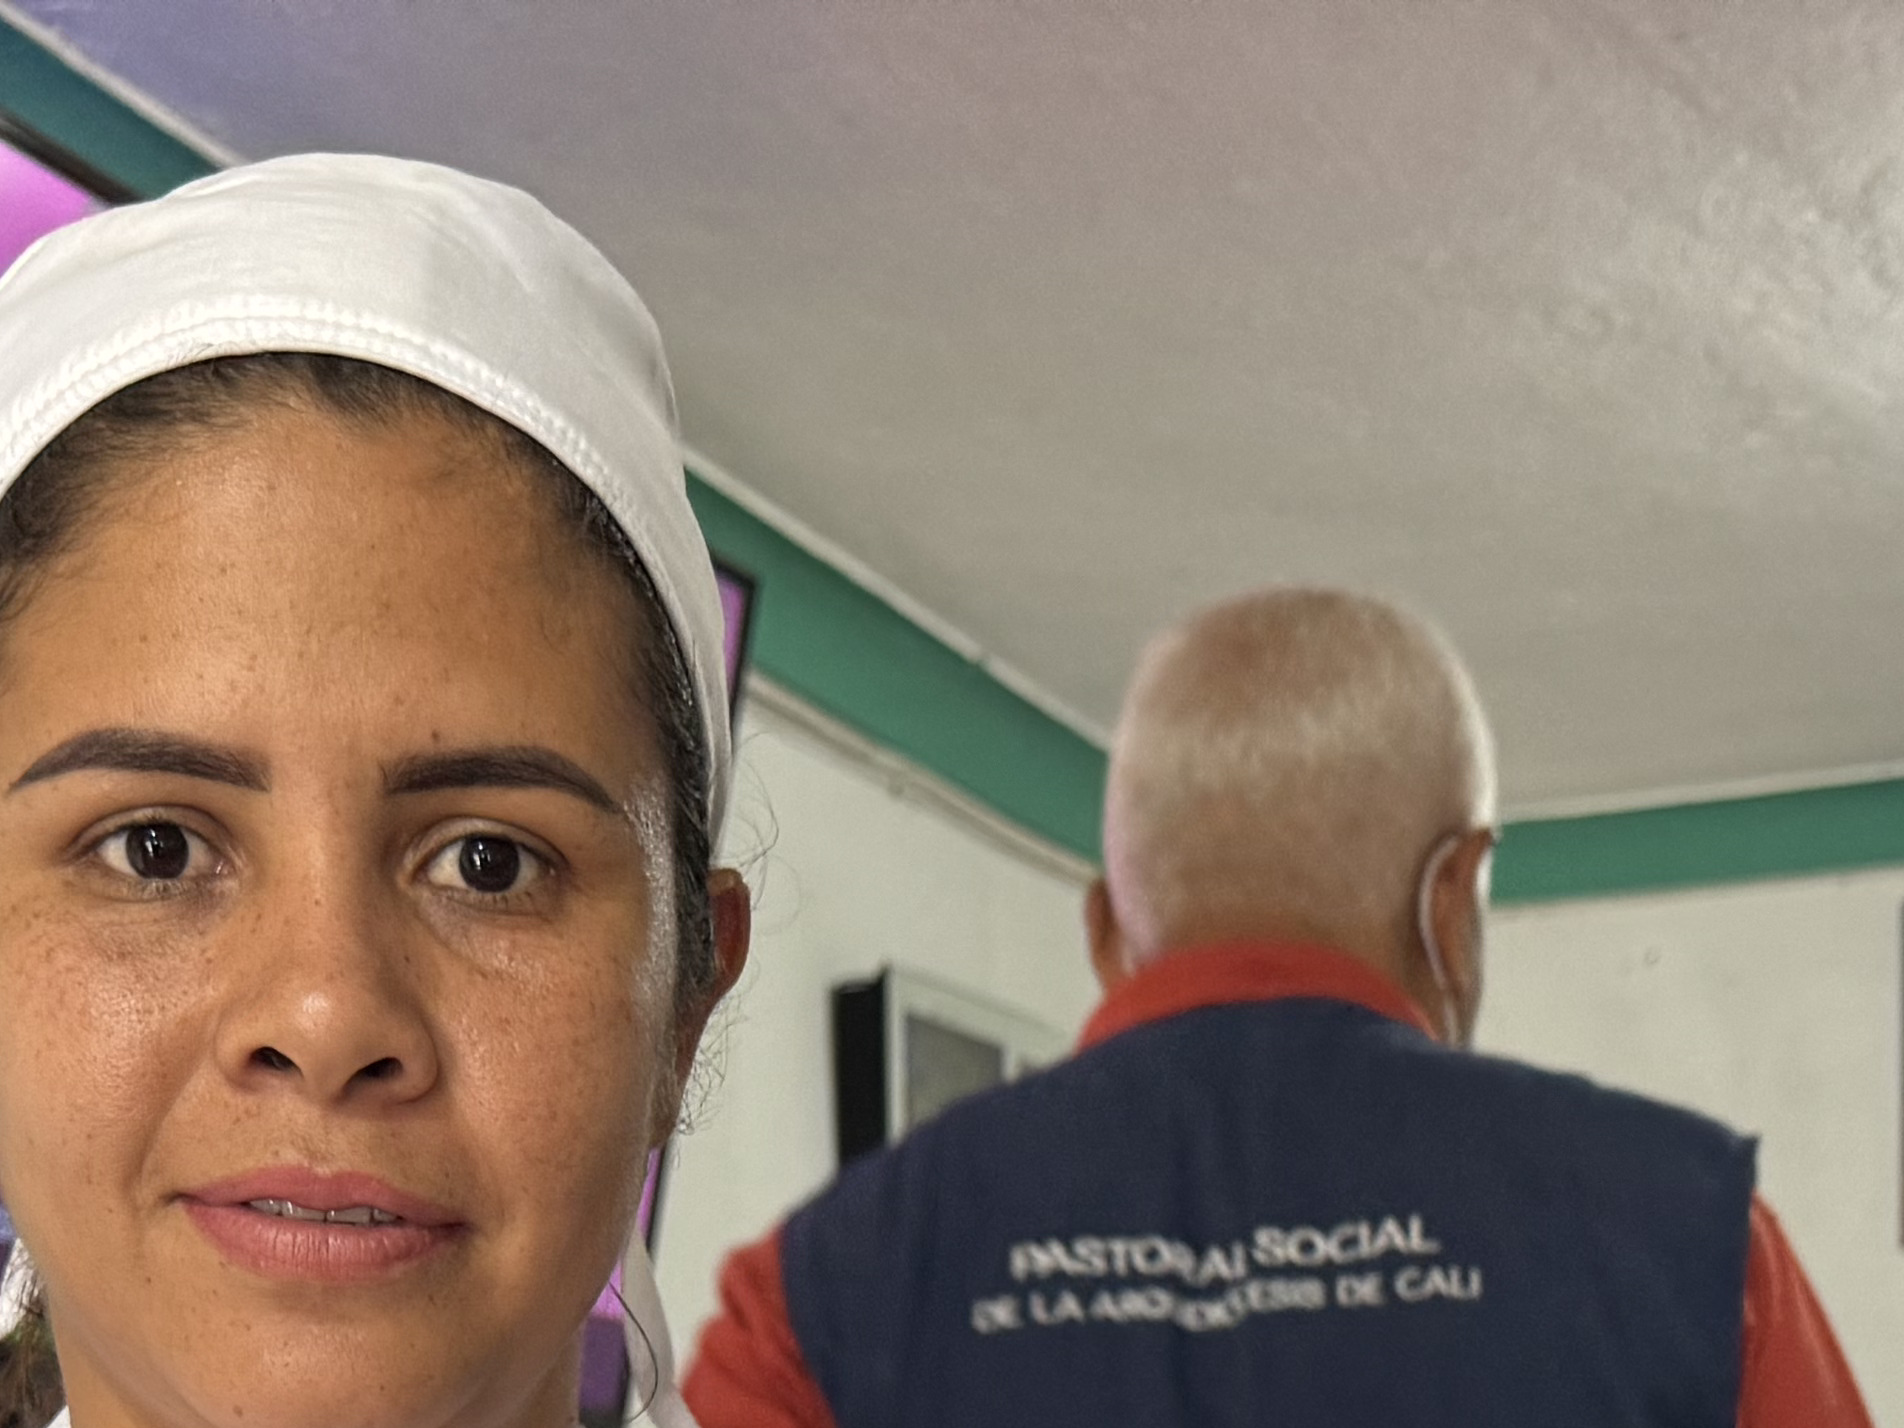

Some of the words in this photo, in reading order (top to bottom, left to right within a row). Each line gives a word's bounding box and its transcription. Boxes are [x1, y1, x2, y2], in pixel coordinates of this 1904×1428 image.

[1252, 1212, 1441, 1267] SOCIAL
[1028, 1289, 1085, 1324] LA
[1335, 1272, 1383, 1308] DE
[1394, 1264, 1484, 1301] CALI
